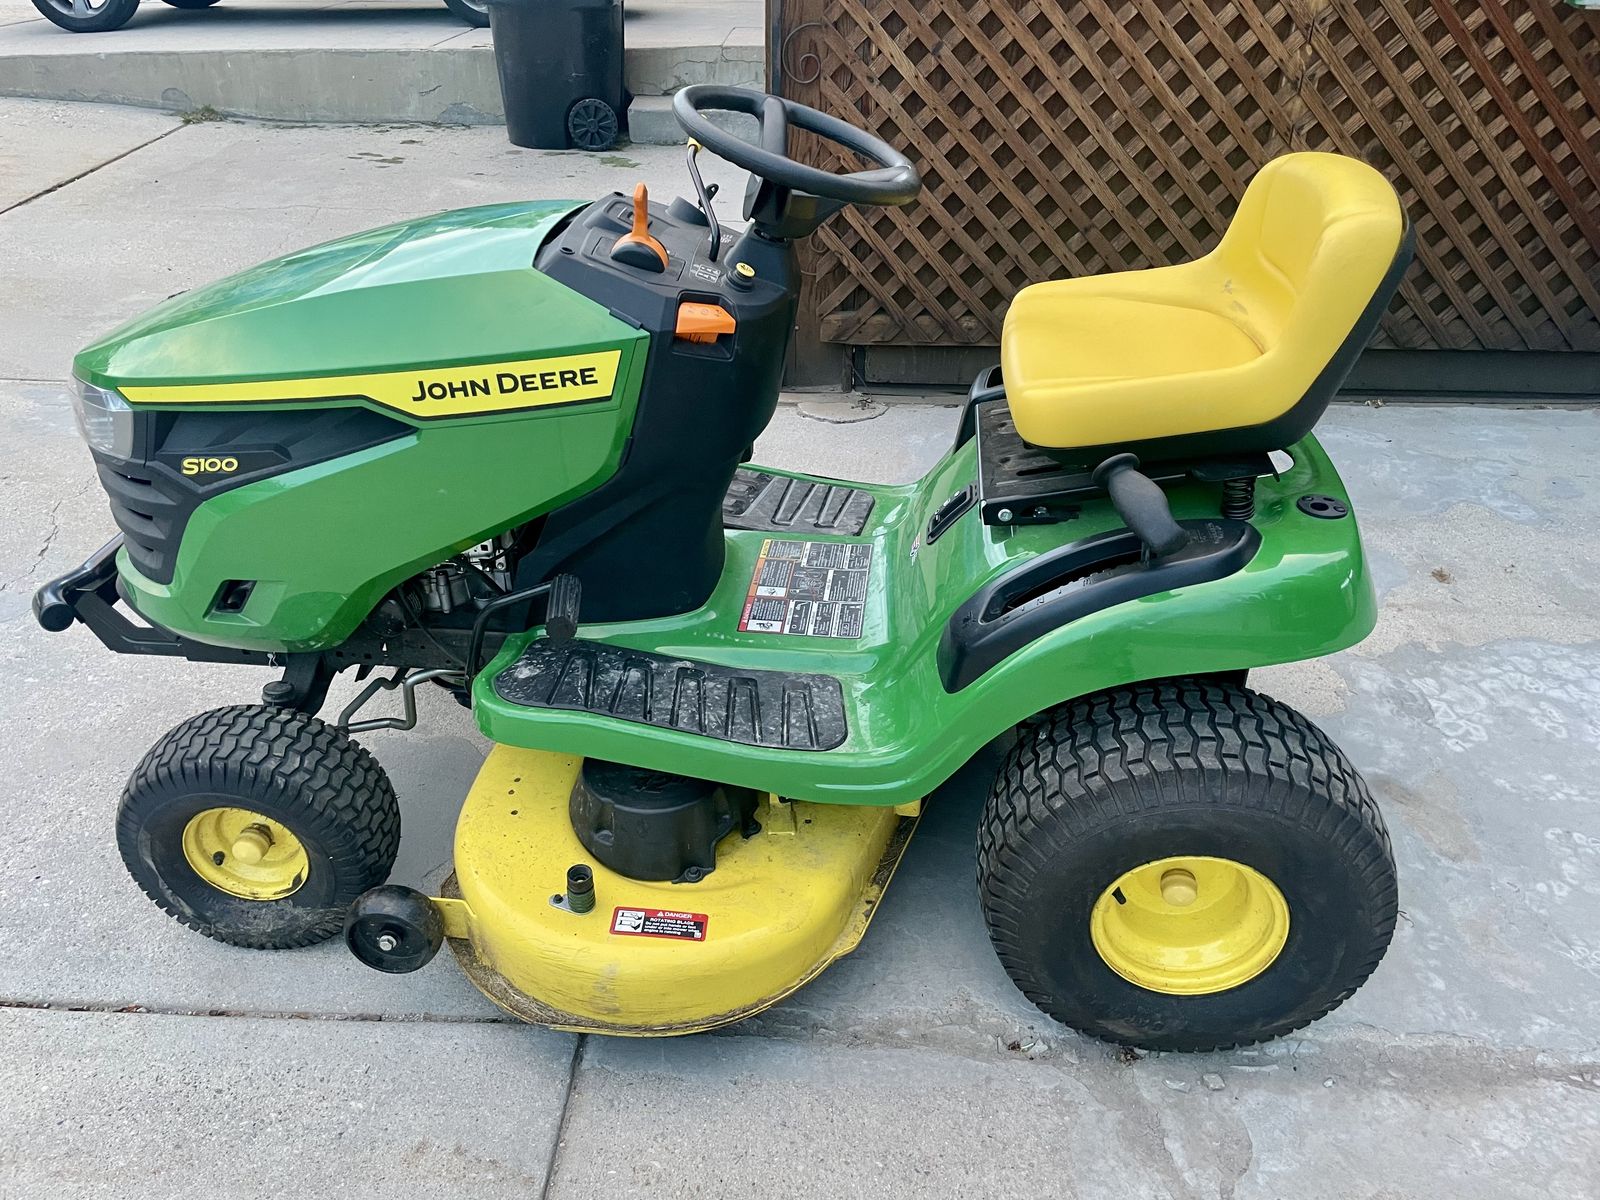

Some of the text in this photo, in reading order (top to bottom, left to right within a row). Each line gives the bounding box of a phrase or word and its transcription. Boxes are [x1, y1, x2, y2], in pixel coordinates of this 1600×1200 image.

[412, 367, 598, 402] JOHN DEERE
[182, 457, 239, 475] S100
